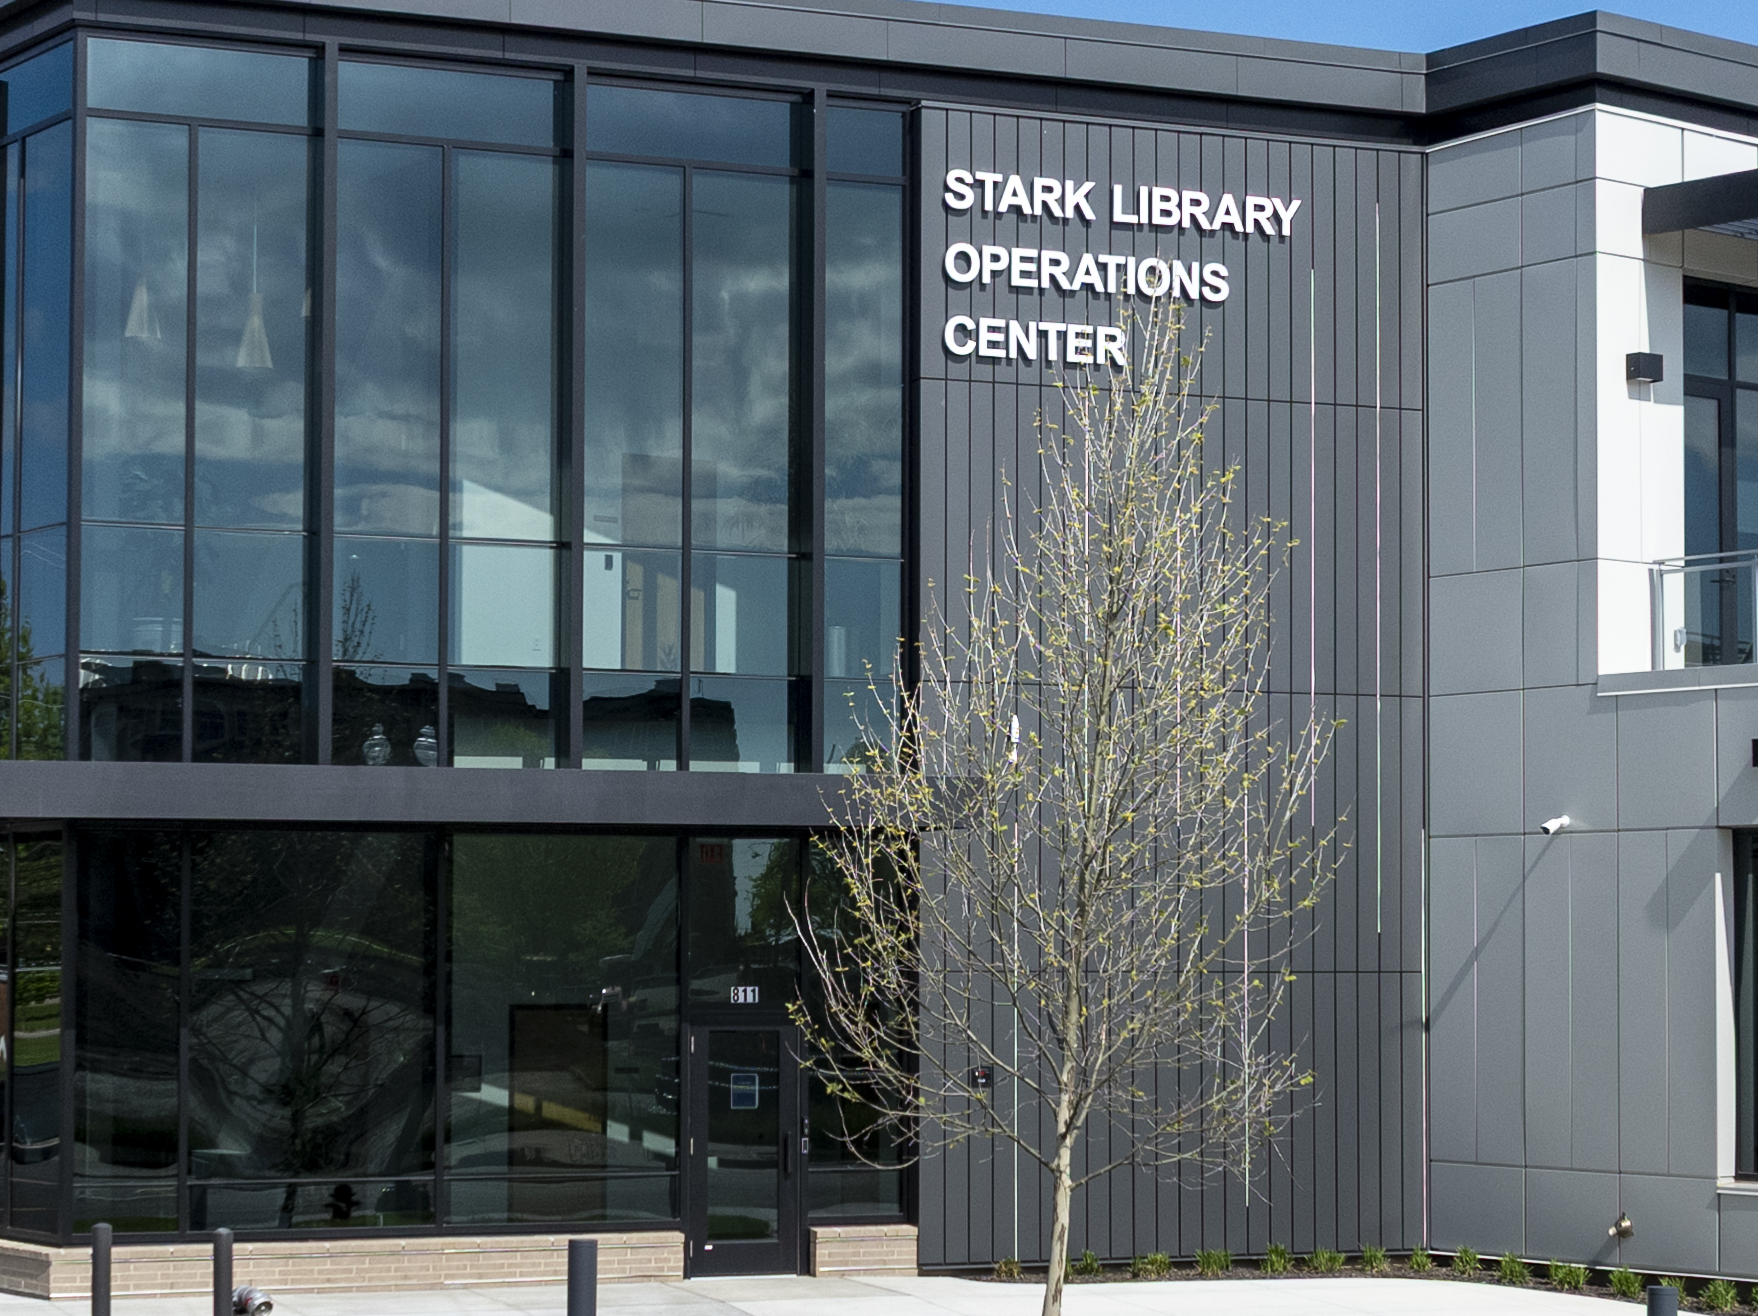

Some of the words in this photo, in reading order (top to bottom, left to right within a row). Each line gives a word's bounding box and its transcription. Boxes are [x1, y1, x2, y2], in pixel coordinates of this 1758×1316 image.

[944, 168, 1097, 221] STARK
[1112, 184, 1303, 237] LIBRARY
[944, 242, 1231, 303] OPERATIONS
[944, 315, 1127, 366] CENTER
[732, 987, 757, 1003] 811
